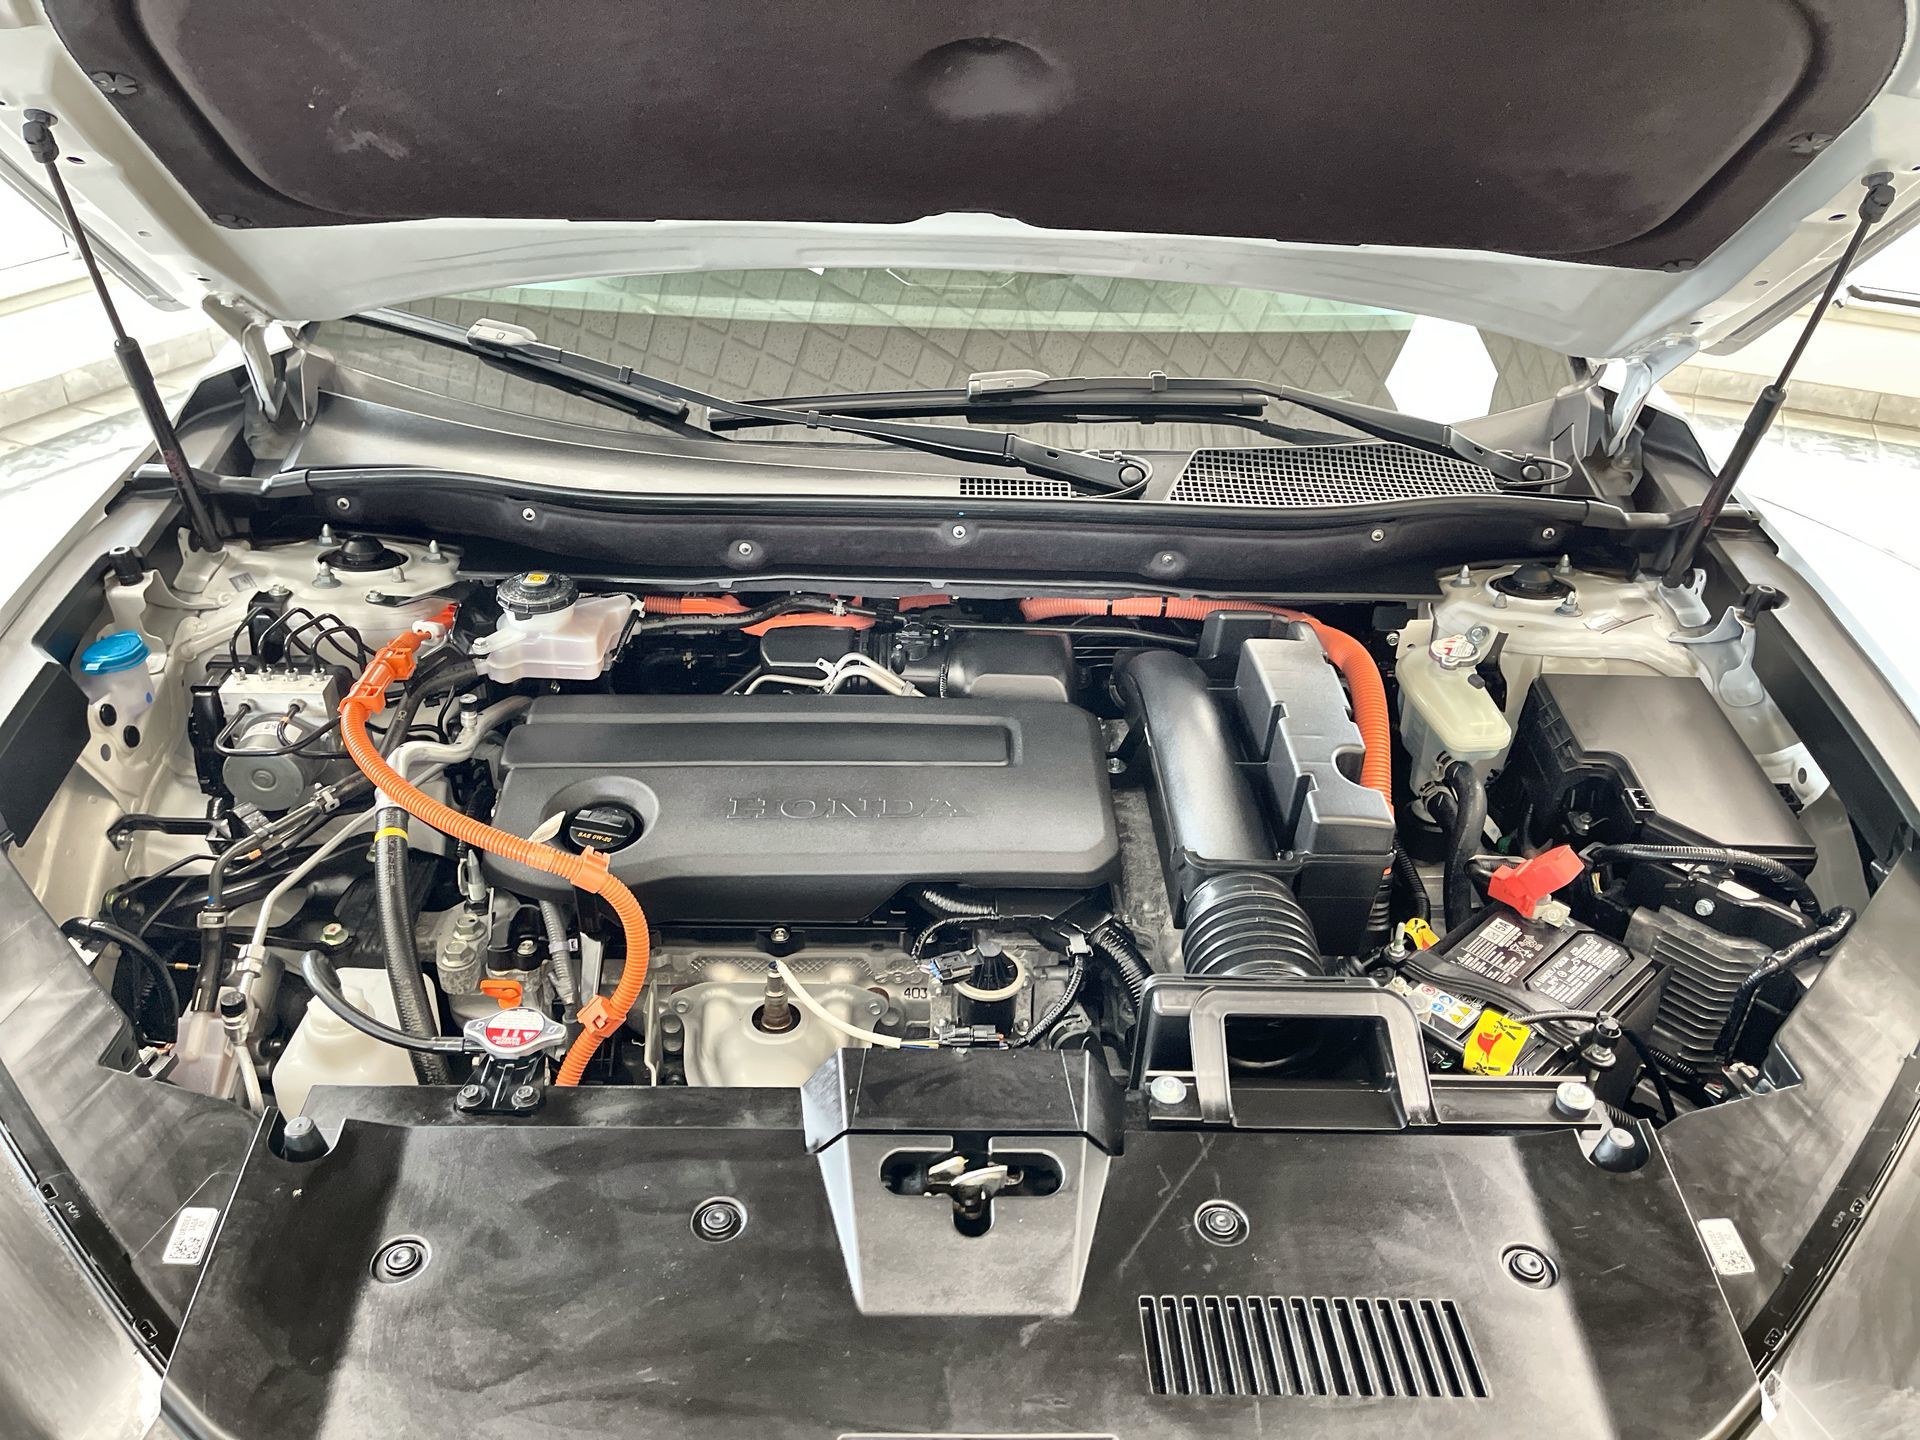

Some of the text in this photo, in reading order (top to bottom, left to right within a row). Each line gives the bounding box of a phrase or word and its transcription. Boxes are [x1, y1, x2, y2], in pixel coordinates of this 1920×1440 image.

[727, 797, 974, 819] HONDA
[592, 834, 612, 843] 0W-20
[1494, 921, 1511, 932] 5A
[904, 987, 928, 999] 403
